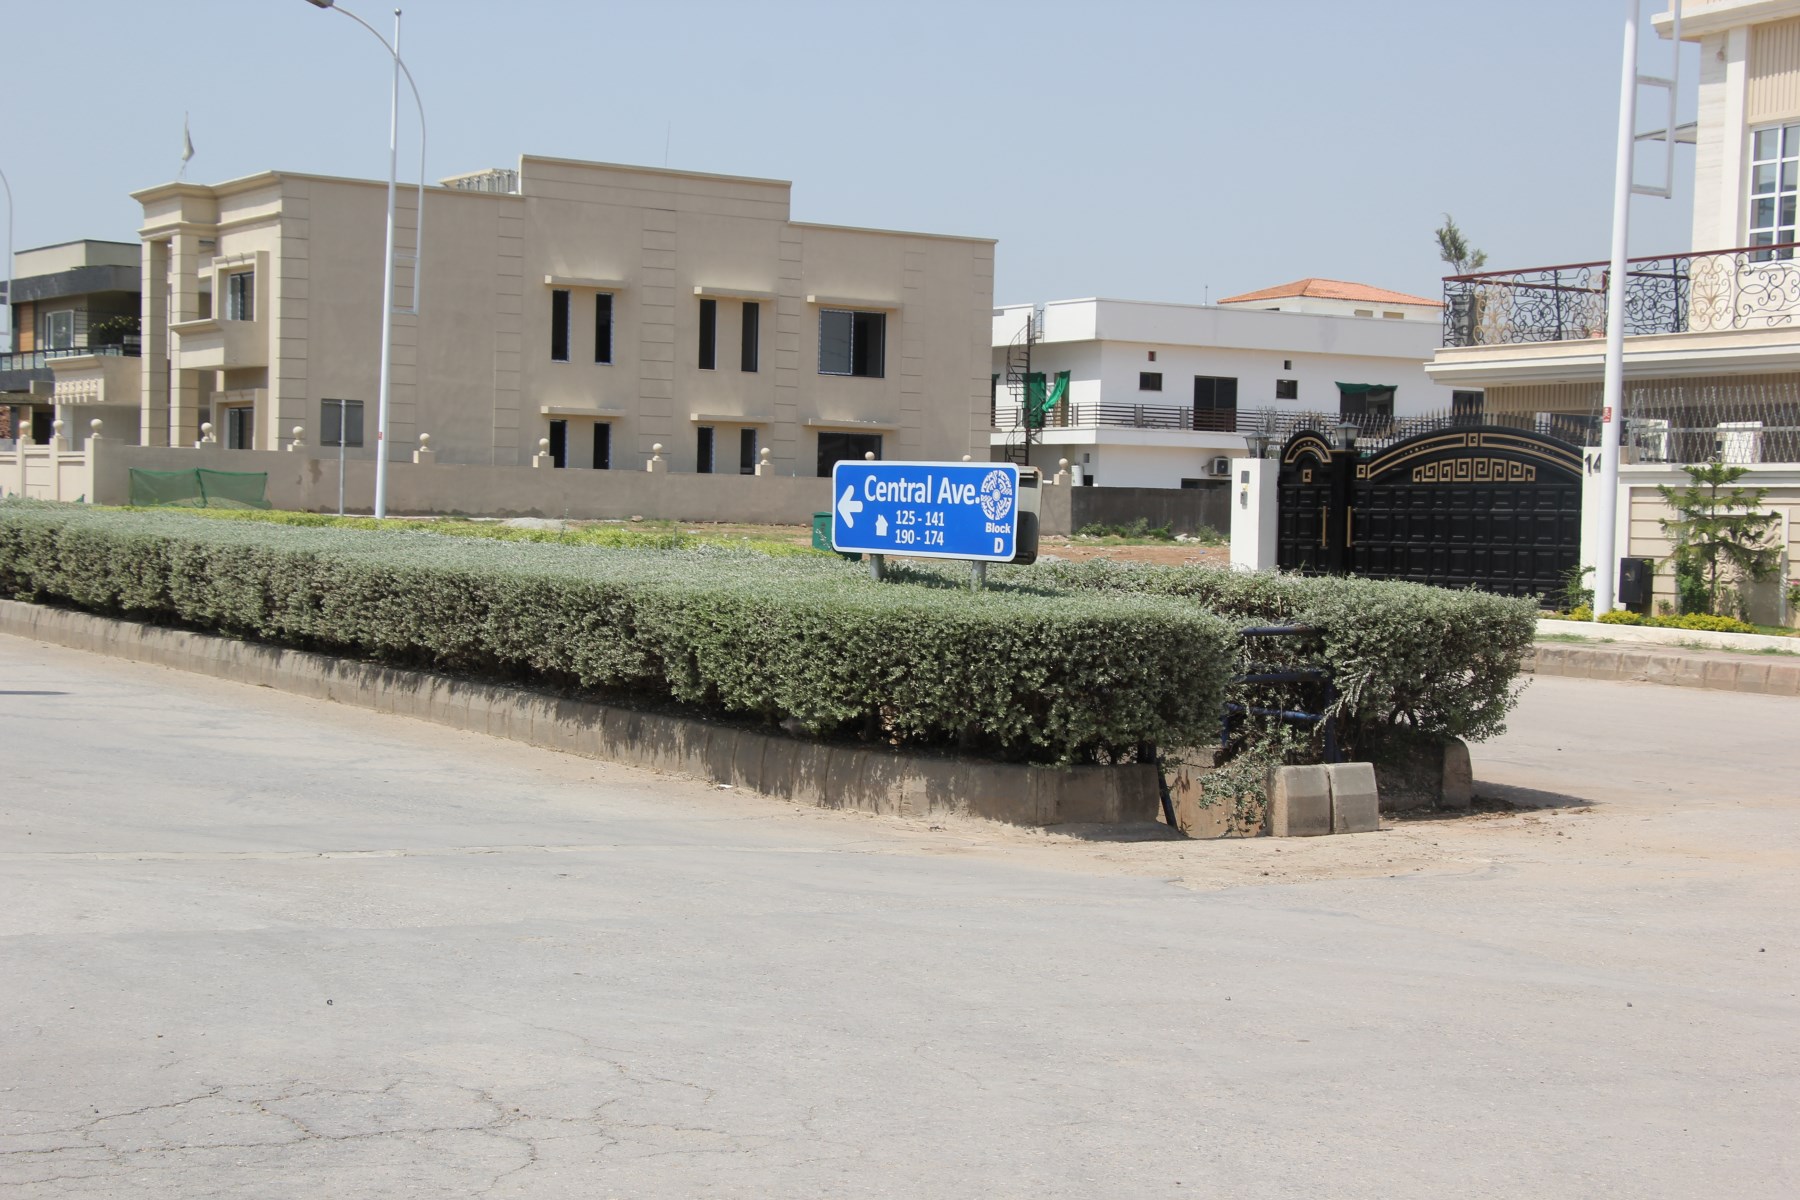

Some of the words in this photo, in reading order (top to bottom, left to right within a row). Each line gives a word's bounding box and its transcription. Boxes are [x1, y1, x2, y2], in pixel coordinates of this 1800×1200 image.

[864, 474, 932, 504] Central
[937, 477, 980, 505] Ave.
[895, 510, 915, 525] 125
[925, 511, 945, 527] 141
[985, 522, 1011, 534] Block
[895, 529, 915, 544] 190
[924, 530, 944, 546] 174
[993, 537, 1004, 553] D
